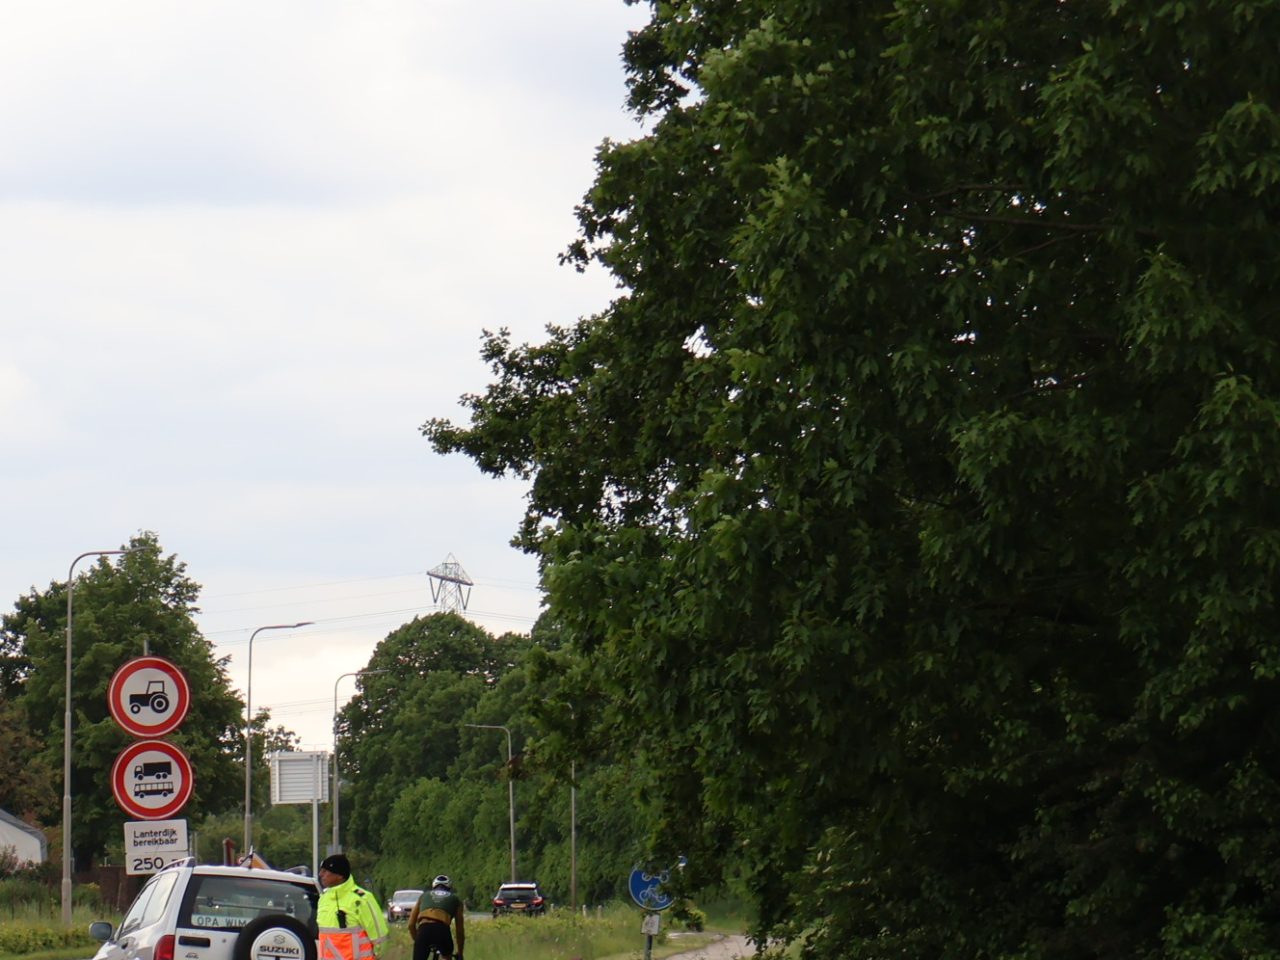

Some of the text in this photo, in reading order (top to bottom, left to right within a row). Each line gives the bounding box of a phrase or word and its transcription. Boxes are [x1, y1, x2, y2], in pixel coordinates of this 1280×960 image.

[133, 828, 177, 839] Lanterdijk
[133, 838, 178, 847] bereikbaar
[133, 857, 164, 871] 250
[197, 916, 246, 928] OPA WIM
[259, 945, 300, 955] SUZUKI
